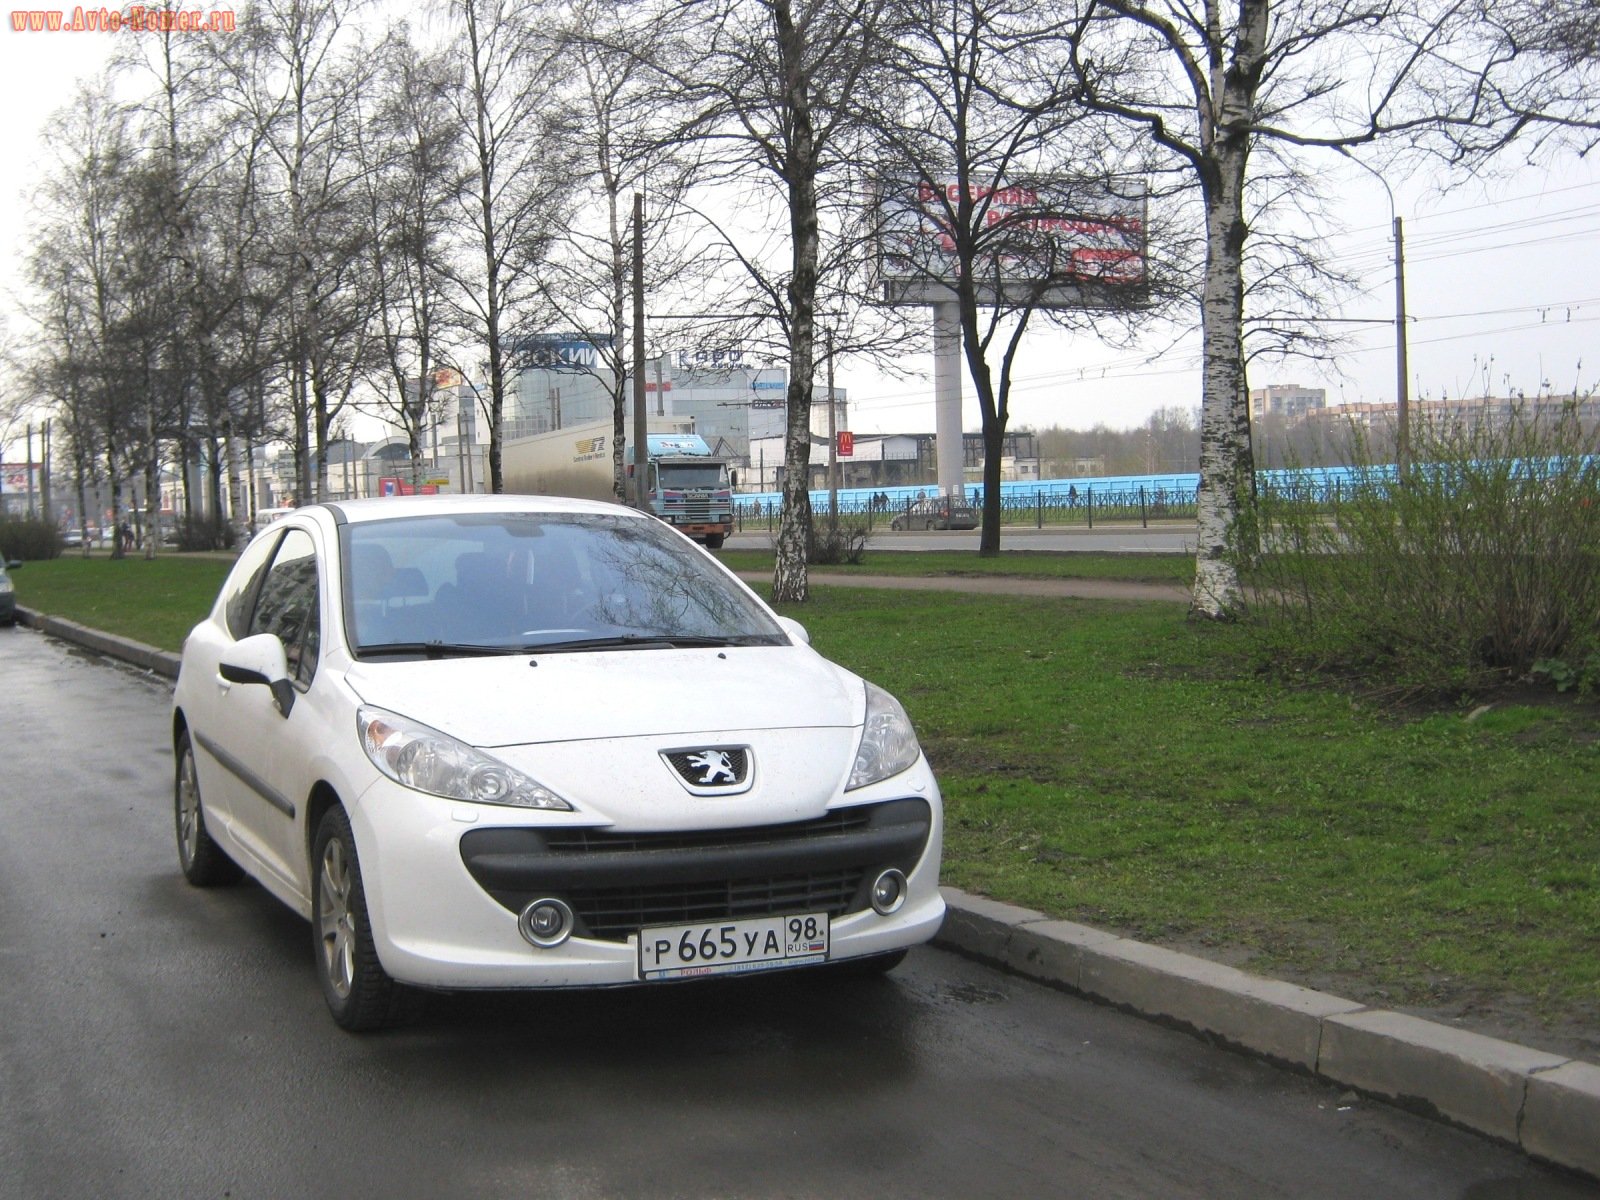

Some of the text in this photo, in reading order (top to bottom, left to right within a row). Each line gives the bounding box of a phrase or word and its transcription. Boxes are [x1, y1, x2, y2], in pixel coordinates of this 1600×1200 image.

[655, 917, 817, 965] Р665УА 98
[787, 943, 808, 953] RUS
